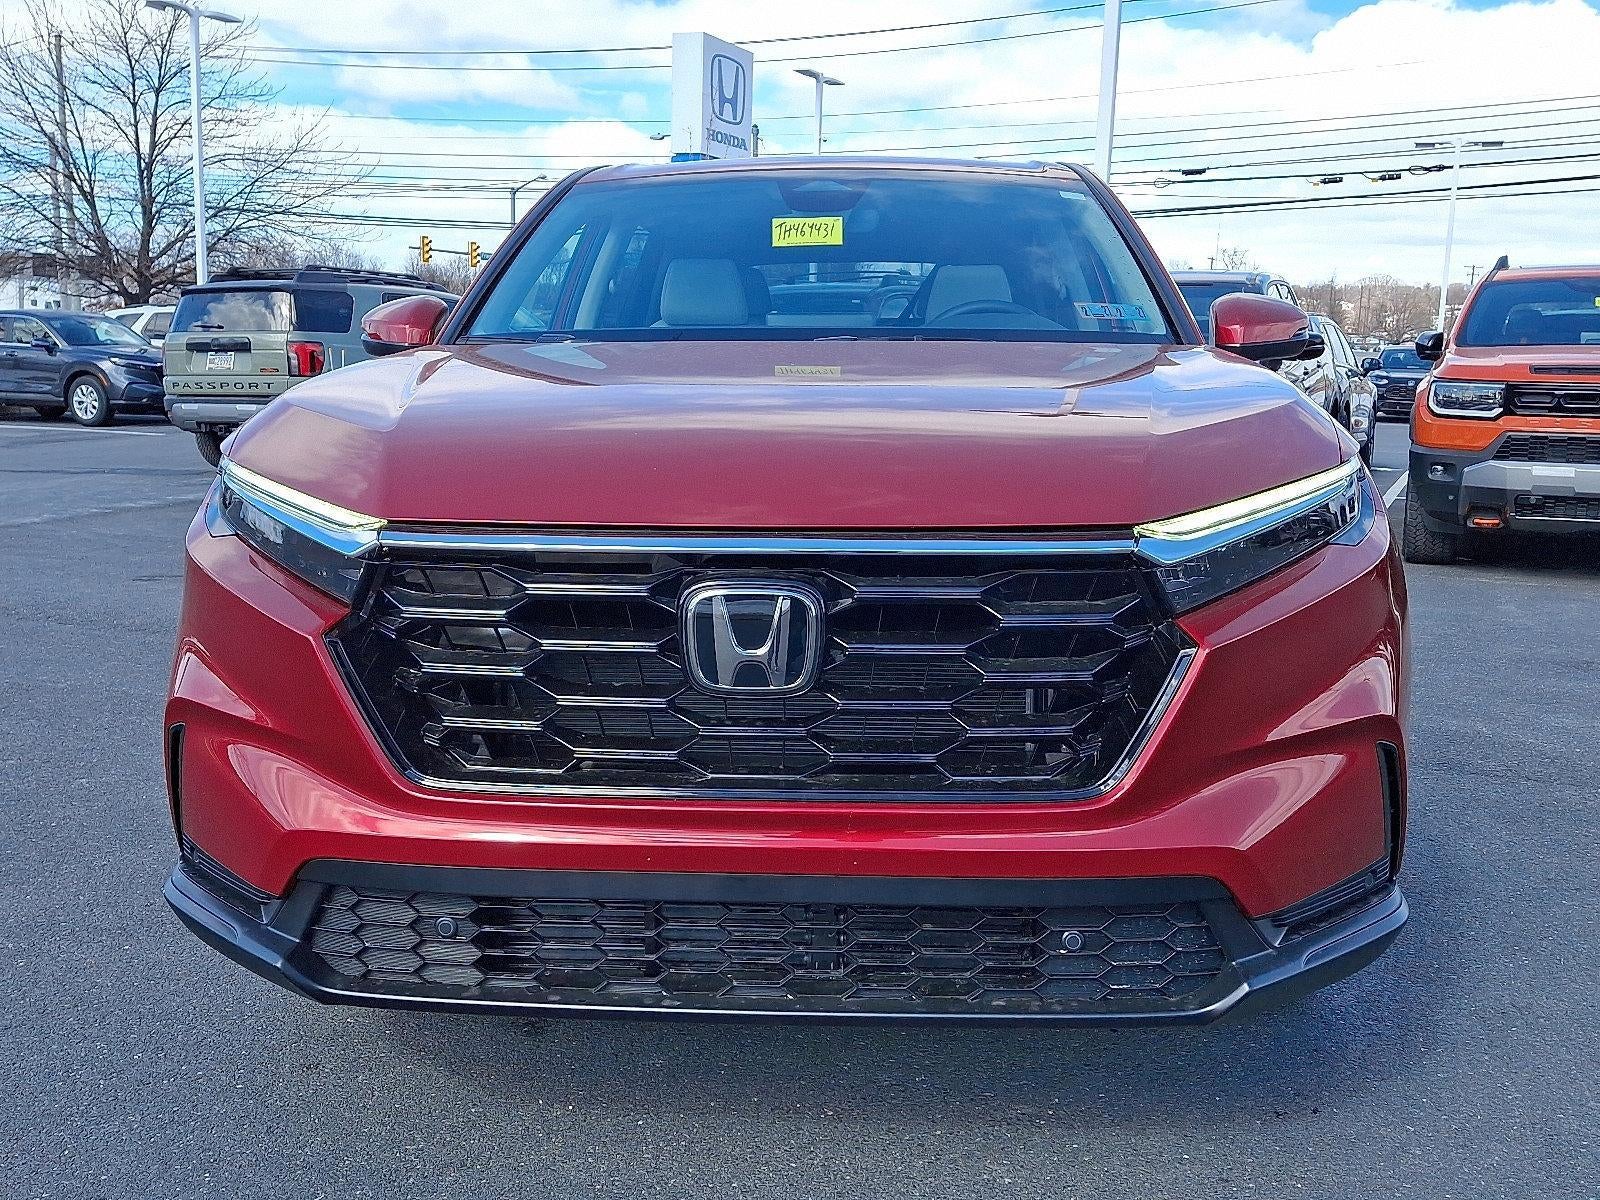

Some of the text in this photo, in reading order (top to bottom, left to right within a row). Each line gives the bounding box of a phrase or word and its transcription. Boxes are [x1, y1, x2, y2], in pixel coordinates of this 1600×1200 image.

[706, 127, 748, 151] HONDA
[774, 221, 835, 242] TH464431
[171, 382, 275, 390] PASSPORT
